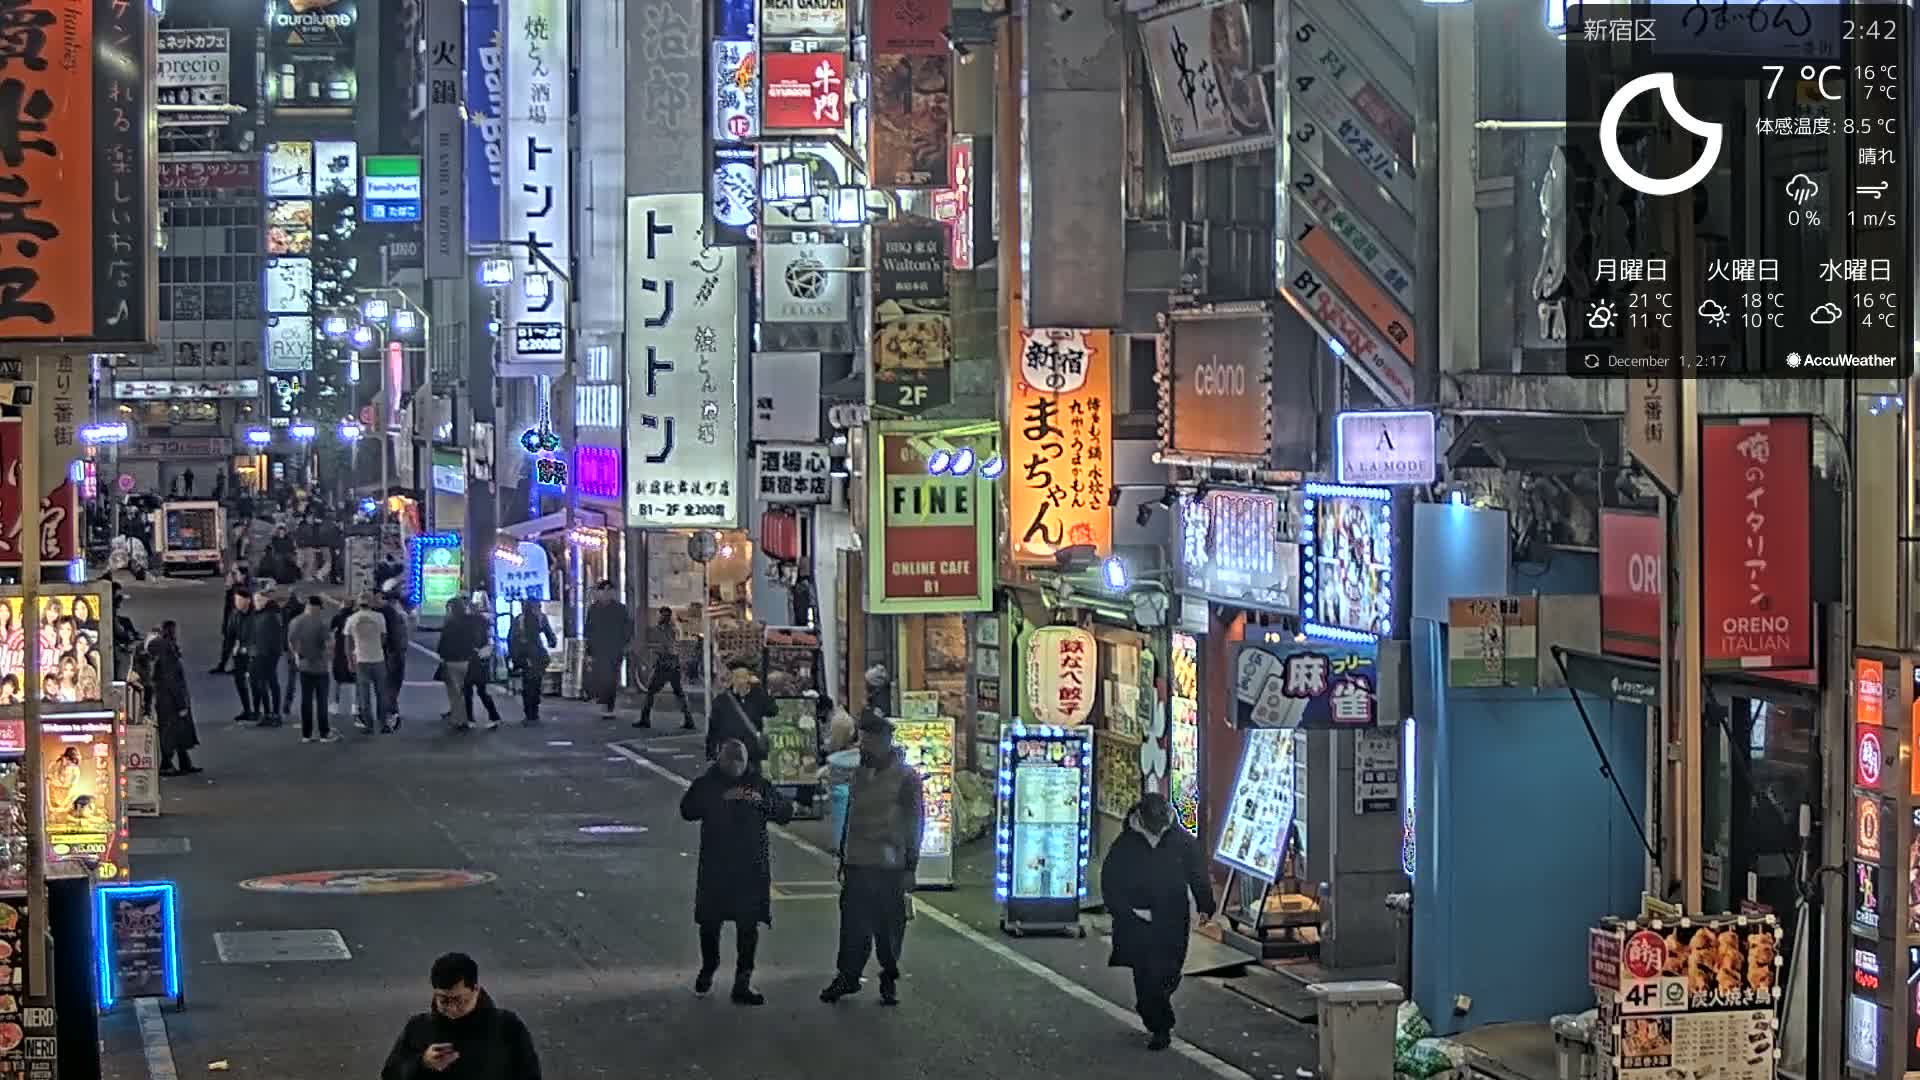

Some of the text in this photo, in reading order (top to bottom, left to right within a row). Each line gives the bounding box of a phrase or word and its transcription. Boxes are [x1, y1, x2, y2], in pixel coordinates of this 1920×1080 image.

[1296, 23, 1317, 43] 5
[431, 41, 457, 104] 火鍋
[812, 60, 841, 122] 牛門
[1296, 75, 1316, 92] 4
[1296, 123, 1316, 144] 3
[1296, 173, 1316, 194] 2
[1298, 223, 1315, 241] 1
[1293, 269, 1323, 300] B1
[641, 210, 674, 463] トントン
[899, 385, 929, 406] 2F
[1022, 396, 1068, 546] まっちゃん
[760, 476, 826, 495] 新宿本店
[893, 486, 968, 515] FINE
[1737, 431, 1772, 607] 俺のイタリアン
[892, 560, 970, 576] ONLINE CAFE
[923, 580, 939, 593] B1
[1722, 616, 1790, 634] ORENO
[1721, 633, 1790, 653] ITALIAN
[1626, 984, 1658, 1006] 4F
[23, 1007, 54, 1027] NERO
[26, 1038, 56, 1058] NERO
